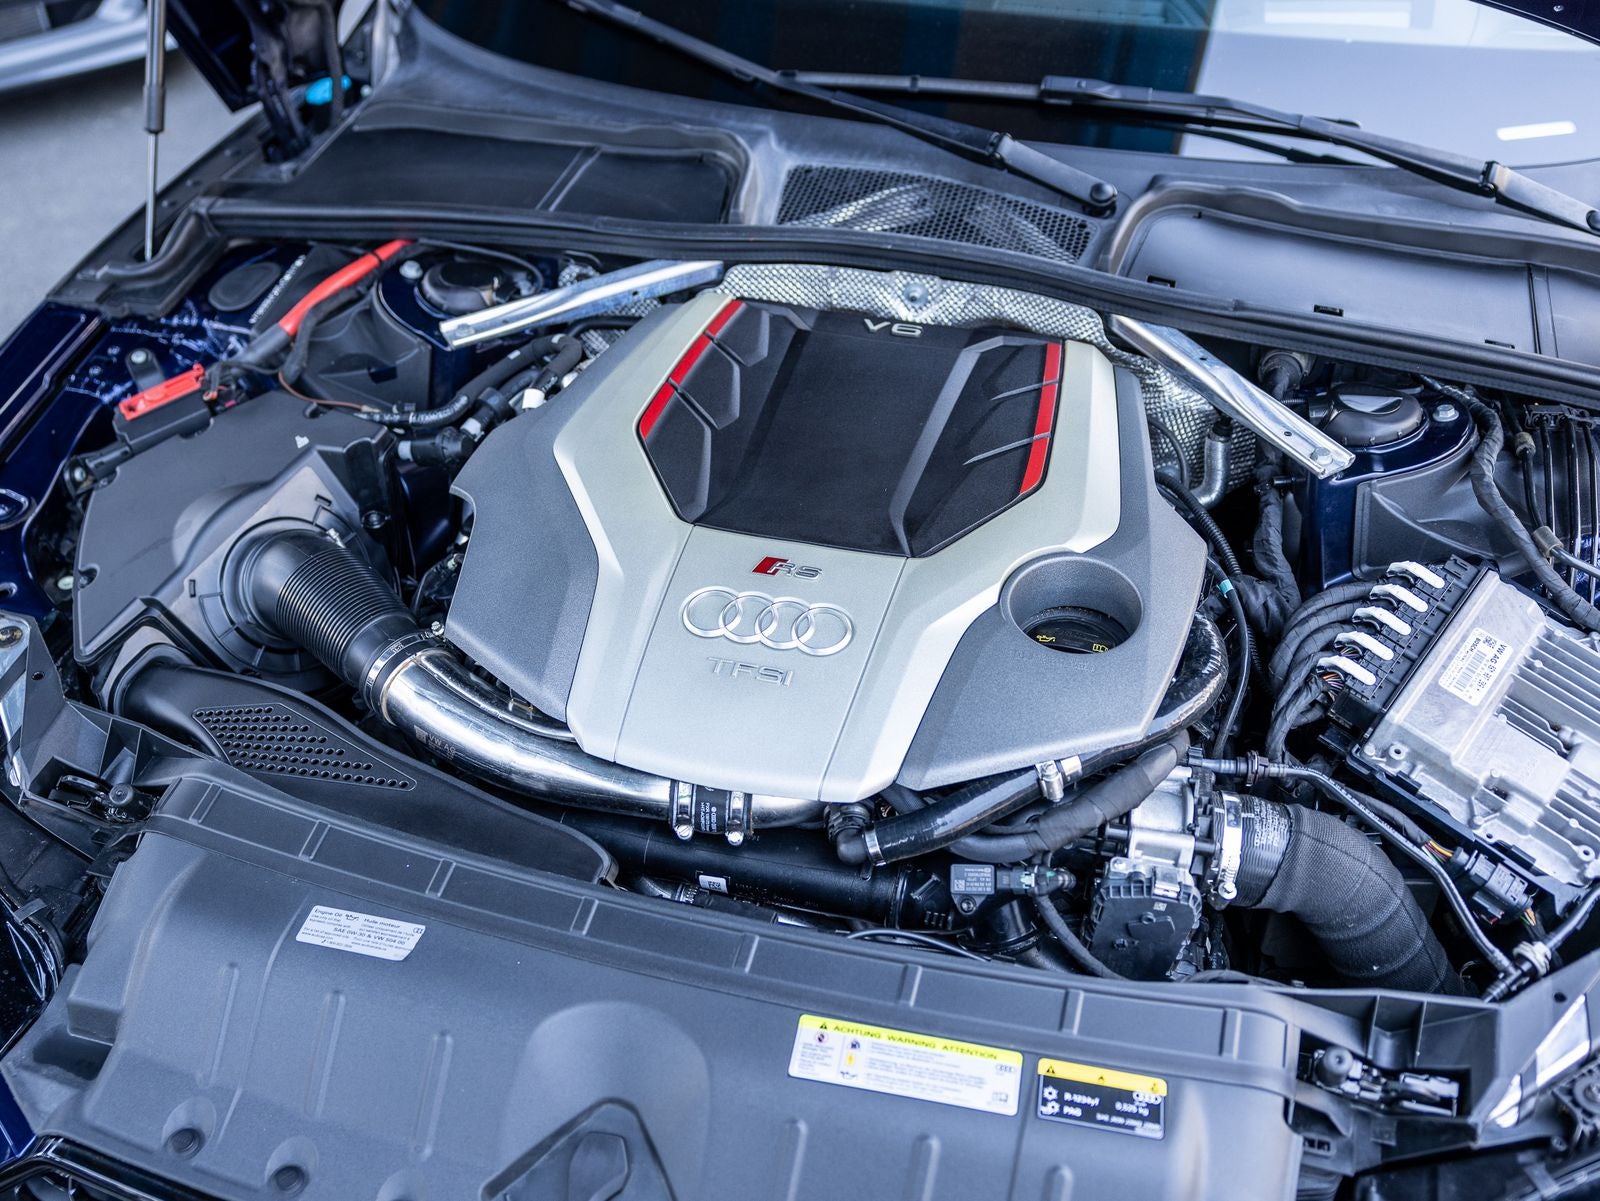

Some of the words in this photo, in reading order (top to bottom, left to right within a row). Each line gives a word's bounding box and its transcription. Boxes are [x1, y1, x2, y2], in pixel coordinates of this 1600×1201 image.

[863, 318, 923, 338] V6
[764, 559, 822, 580] RS
[1496, 644, 1507, 656] VW
[1490, 654, 1500, 664] AG
[706, 656, 794, 688] TFSI
[314, 908, 334, 918] Engine
[364, 917, 379, 925] Huile
[379, 921, 402, 929] moteur
[833, 1026, 882, 1040] ACHTUNG
[886, 1035, 937, 1050] WARNING
[942, 1044, 998, 1060] ATTENTION
